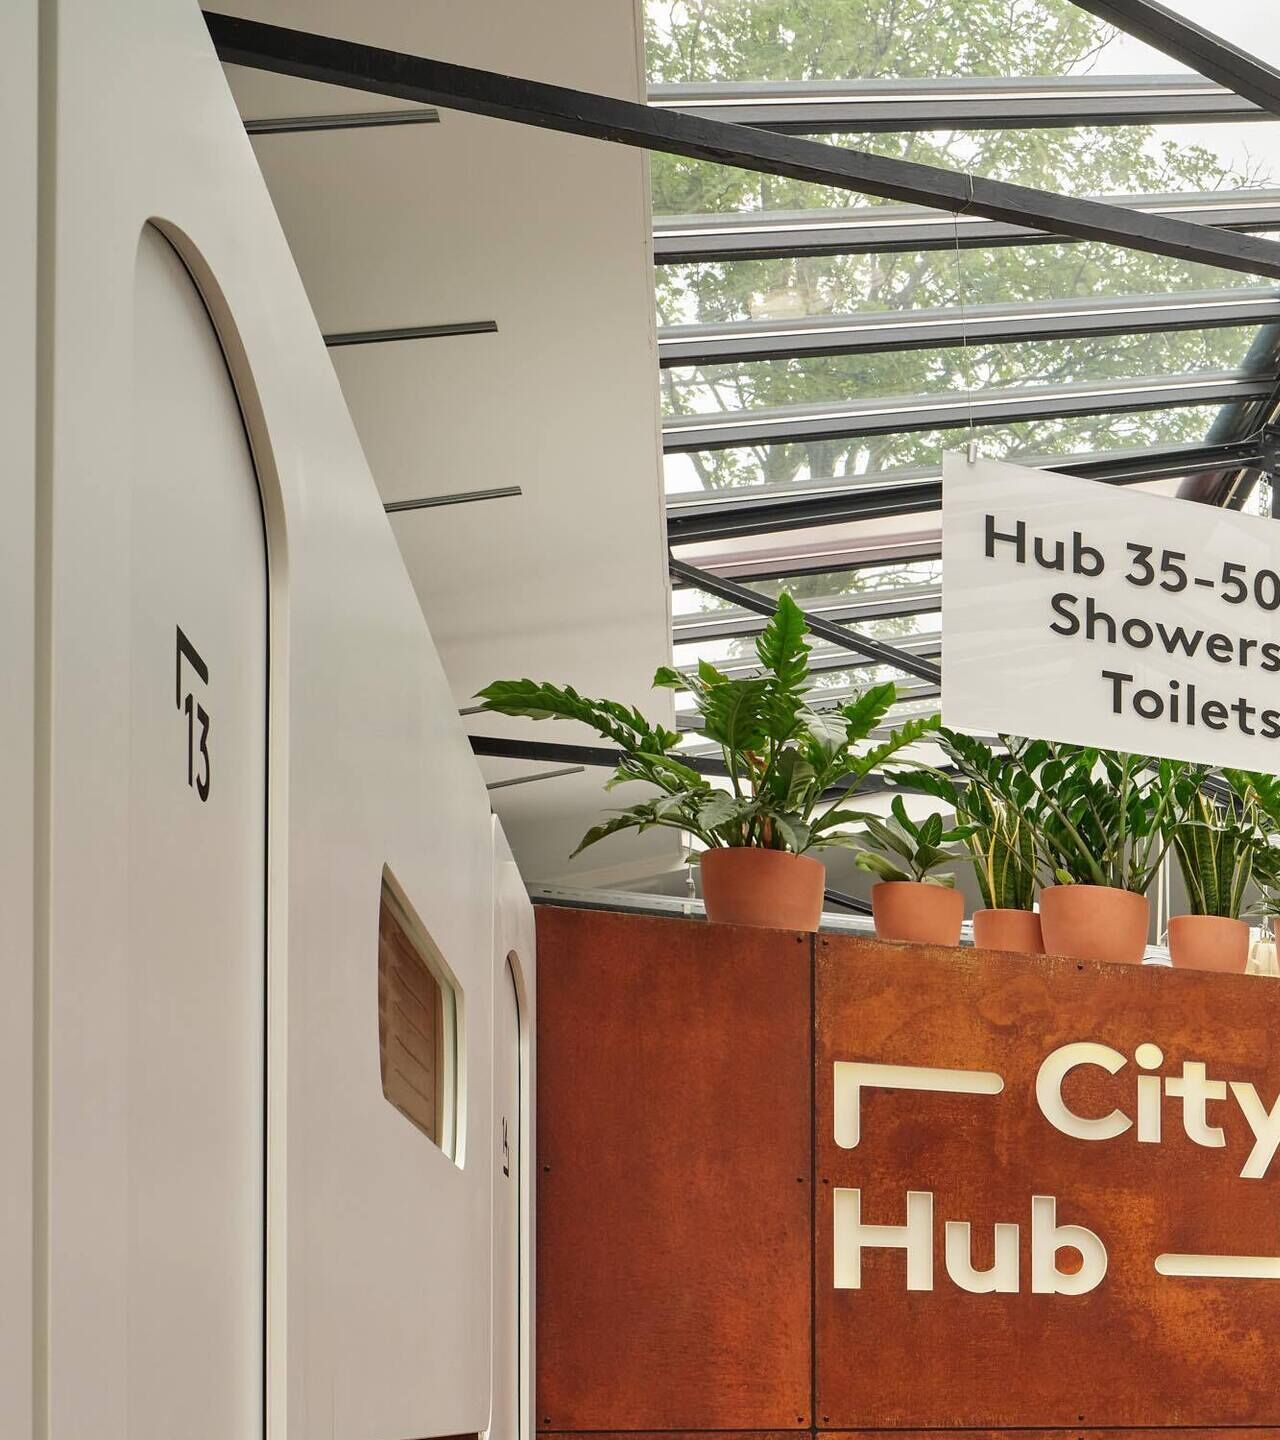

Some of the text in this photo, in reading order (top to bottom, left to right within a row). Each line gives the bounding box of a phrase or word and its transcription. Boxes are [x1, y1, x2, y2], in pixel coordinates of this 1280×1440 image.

[985, 514, 1105, 577] Hub
[185, 693, 210, 802] 13
[833, 1187, 1107, 1296] Hub
